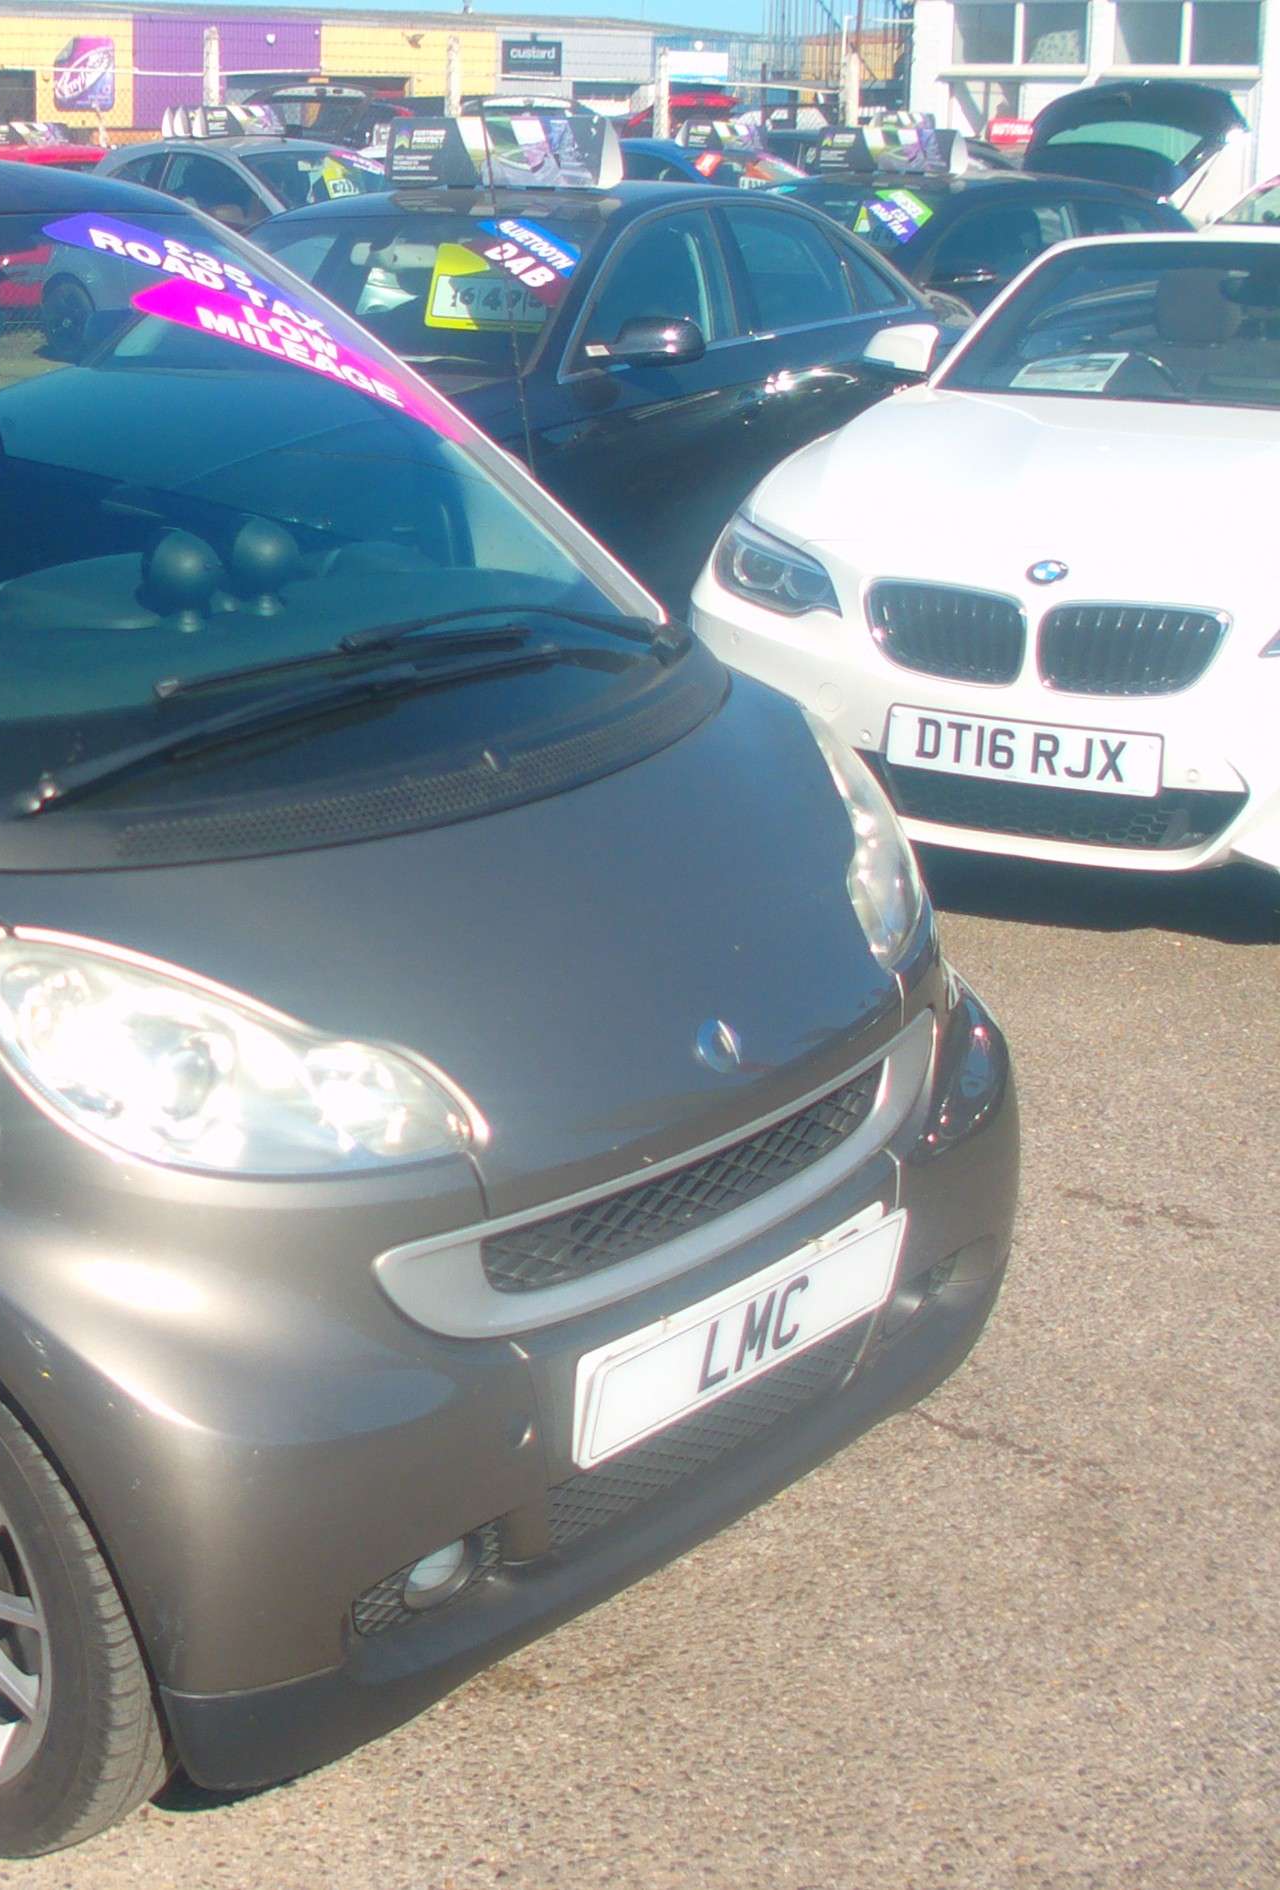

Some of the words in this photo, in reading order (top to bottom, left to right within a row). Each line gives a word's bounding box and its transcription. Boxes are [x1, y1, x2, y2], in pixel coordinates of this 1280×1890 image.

[510, 46, 556, 60] custard
[162, 238, 254, 288] £35
[483, 242, 556, 288] DAB
[497, 219, 577, 271] BLUETOOTH
[88, 227, 226, 292] ROAD
[235, 283, 332, 341] TAX
[195, 306, 405, 409] MILEAGE
[241, 305, 339, 361] LOW
[914, 716, 1016, 771] DT16
[1030, 731, 1128, 783] RJX
[697, 1274, 810, 1394] LMC
